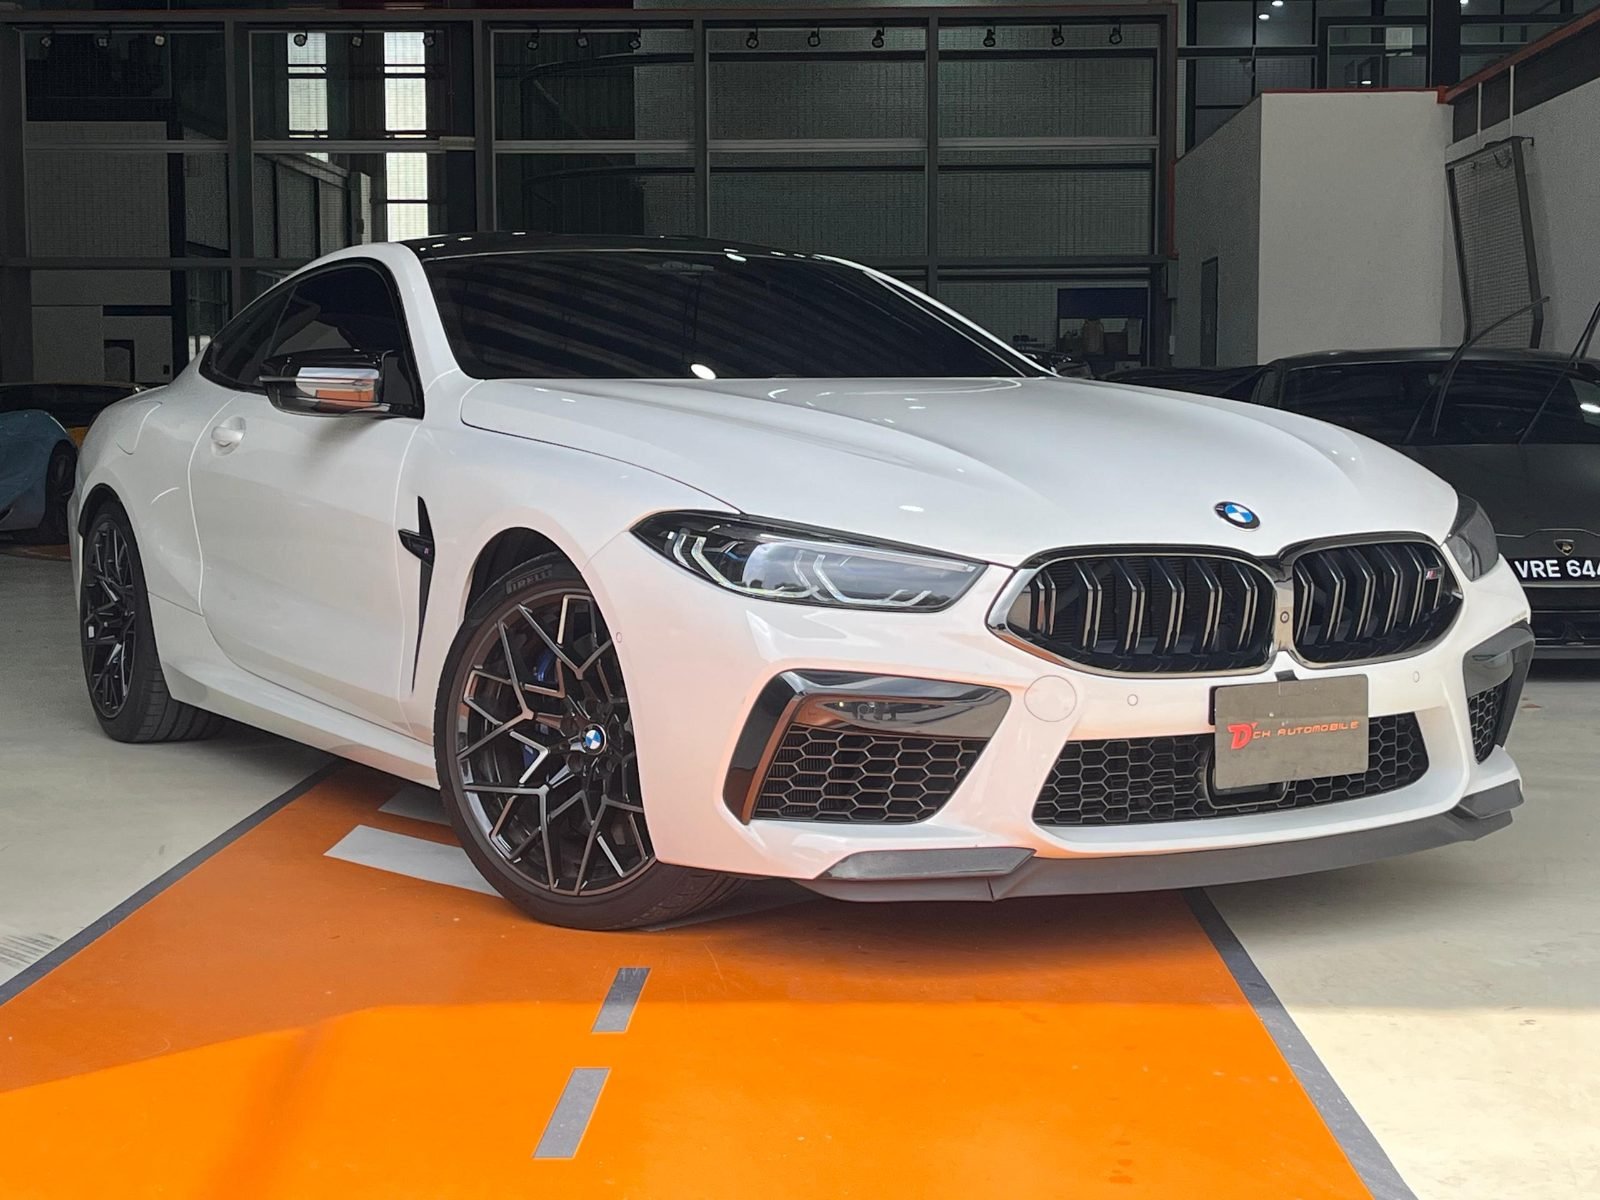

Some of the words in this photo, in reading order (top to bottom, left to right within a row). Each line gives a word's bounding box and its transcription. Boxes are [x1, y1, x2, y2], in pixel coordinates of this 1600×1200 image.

[1514, 560, 1561, 578] VRE
[1566, 559, 1600, 578] 64
[1277, 721, 1360, 737] AUTOMOBILE
